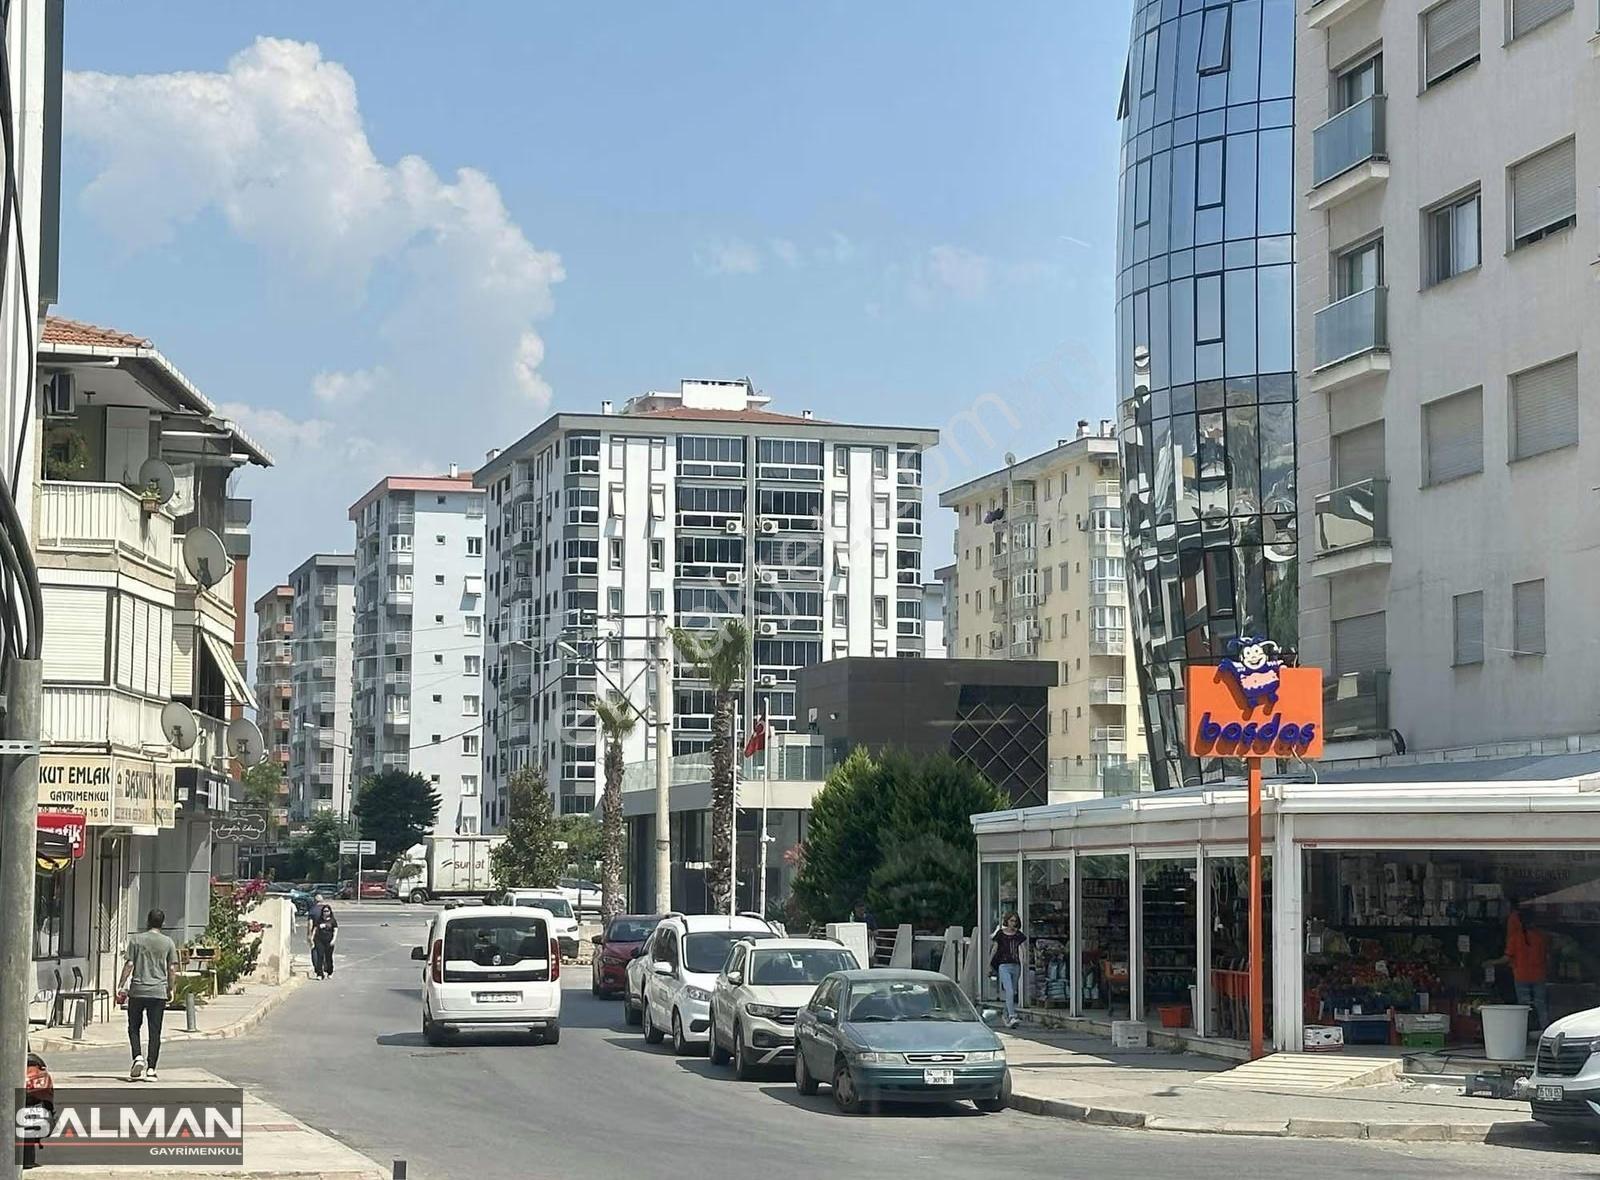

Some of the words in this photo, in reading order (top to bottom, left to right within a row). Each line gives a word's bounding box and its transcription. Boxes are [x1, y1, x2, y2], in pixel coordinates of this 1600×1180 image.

[68, 766, 110, 786] EMLAK
[89, 807, 99, 818] 16
[100, 807, 109, 818] 10
